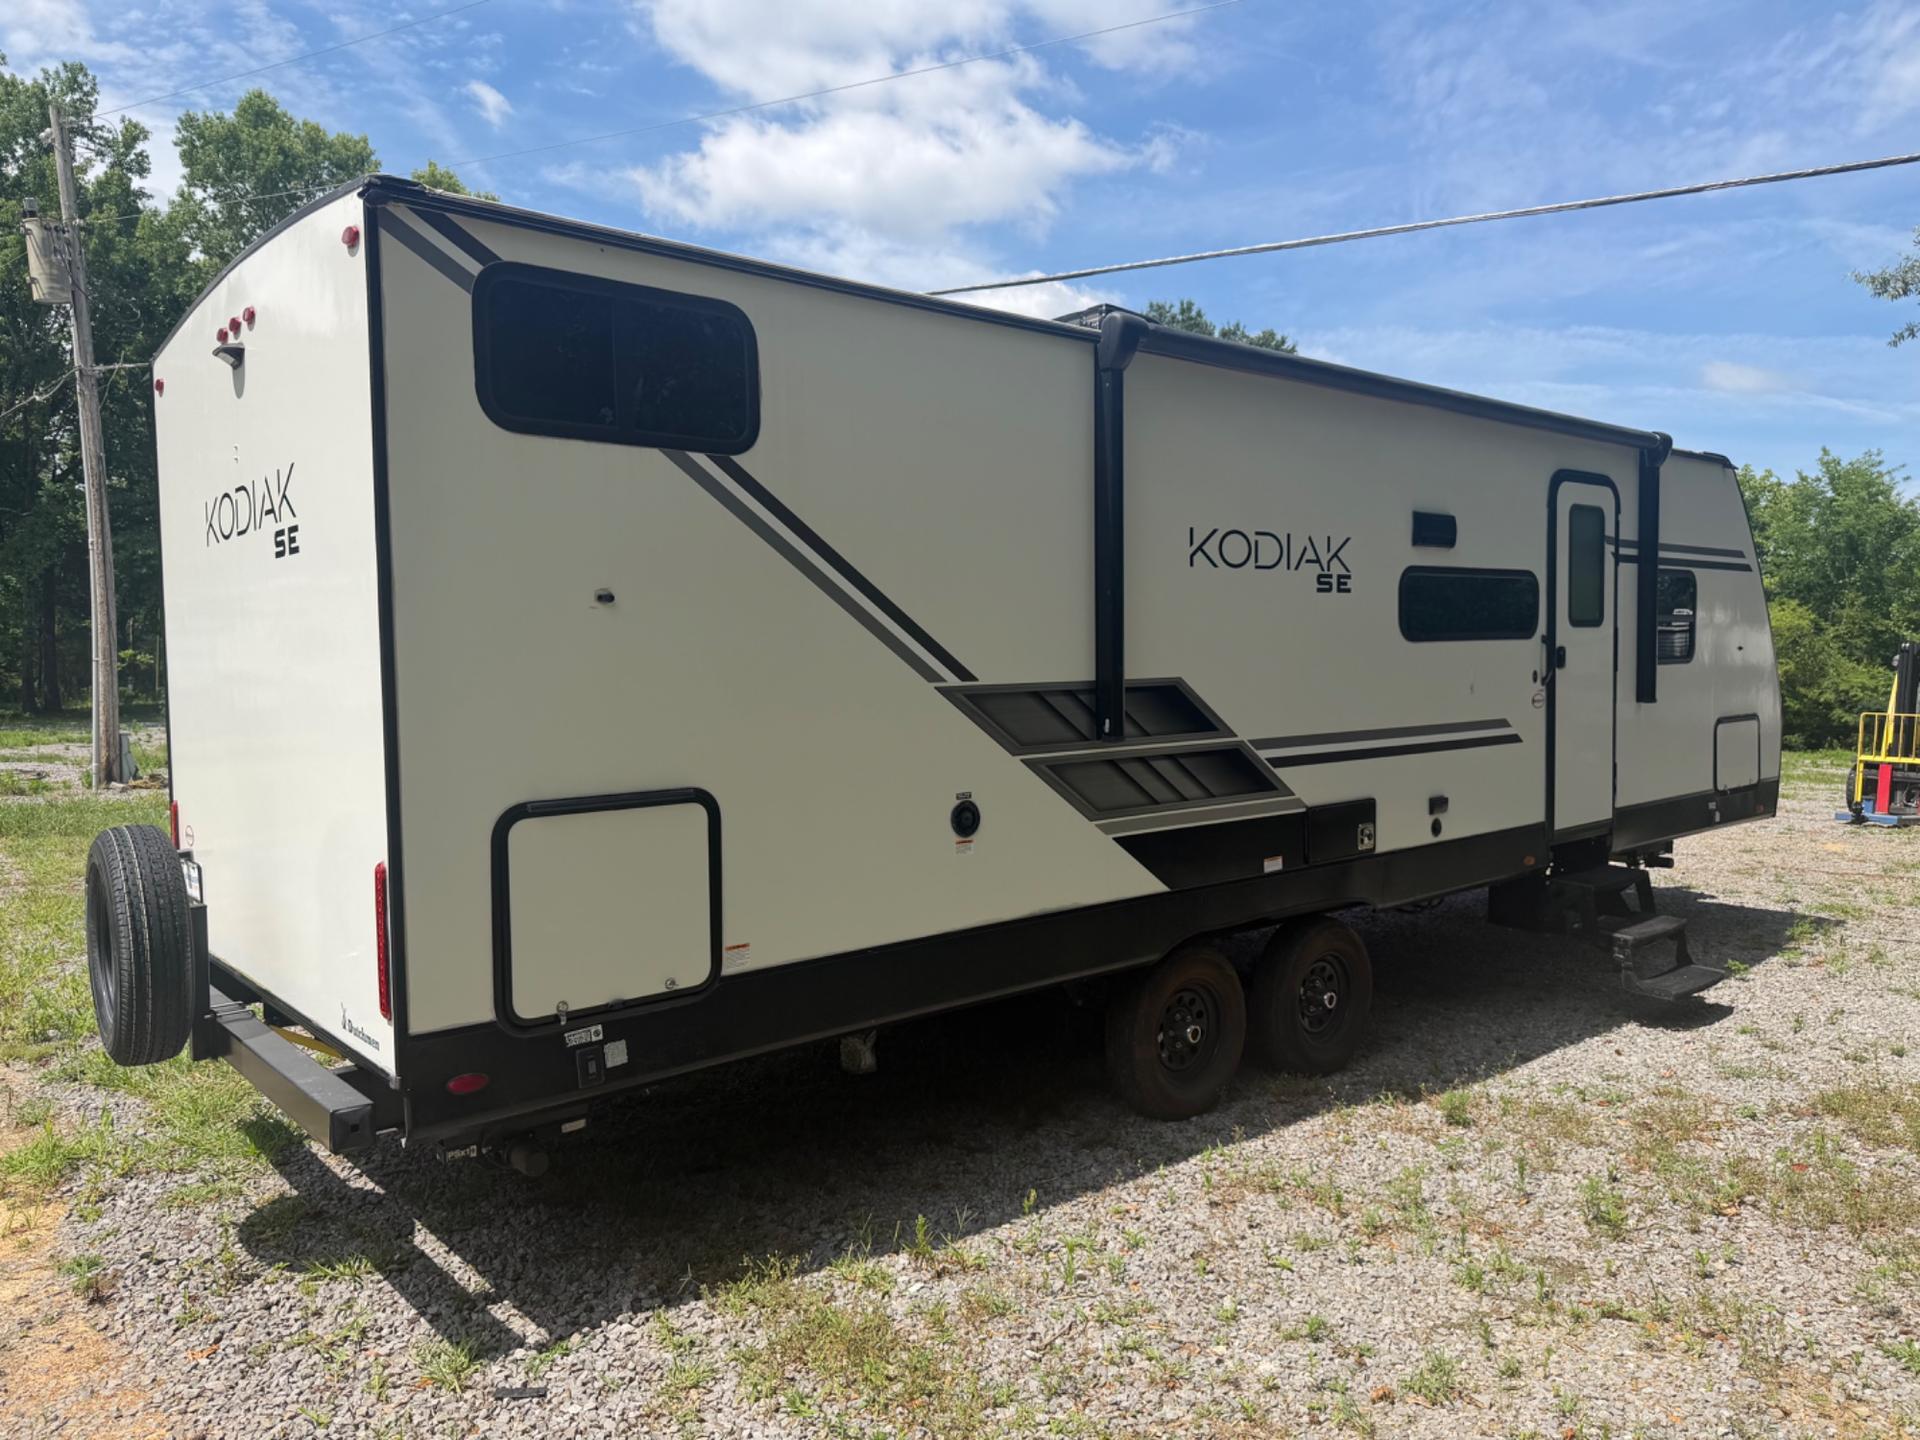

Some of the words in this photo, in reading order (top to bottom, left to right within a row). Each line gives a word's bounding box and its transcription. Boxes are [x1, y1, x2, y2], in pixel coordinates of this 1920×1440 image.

[205, 462, 296, 547] KODIAK
[274, 524, 300, 559] SE
[1189, 527, 1351, 573] KODIAK
[1316, 573, 1352, 593] SE
